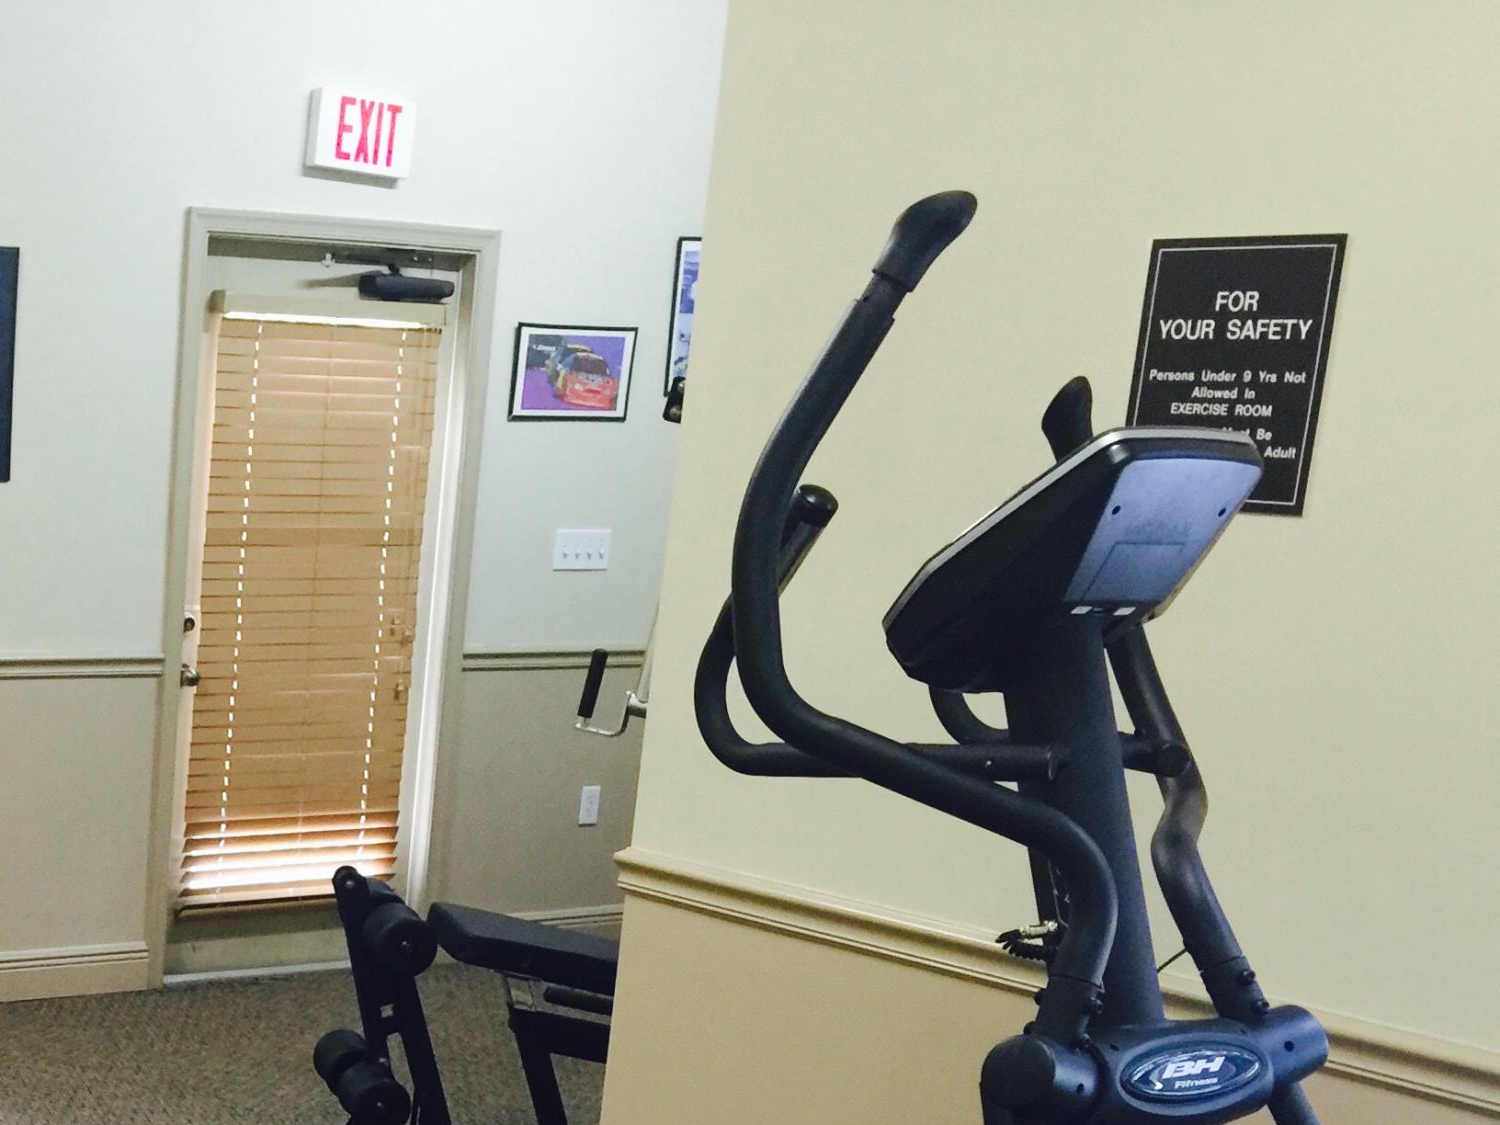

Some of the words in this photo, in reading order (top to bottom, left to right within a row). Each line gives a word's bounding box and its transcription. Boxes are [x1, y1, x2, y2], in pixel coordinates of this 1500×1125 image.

[335, 95, 403, 167] EXIT
[1214, 290, 1260, 312] FOR
[1159, 319, 1216, 340] YOUR
[1226, 318, 1313, 341] SAFETY
[1149, 369, 1195, 382] Persons
[1201, 370, 1237, 383] Under
[1243, 370, 1251, 382] 9
[1259, 371, 1277, 383] Yrs
[1284, 370, 1306, 384] Not
[1191, 387, 1238, 399] Allowed
[1170, 403, 1228, 416] EXERCISE
[1234, 404, 1273, 417] ROOM
[1256, 428, 1272, 440] Be
[1263, 445, 1297, 460] Adult
[1162, 1056, 1226, 1079] BH
